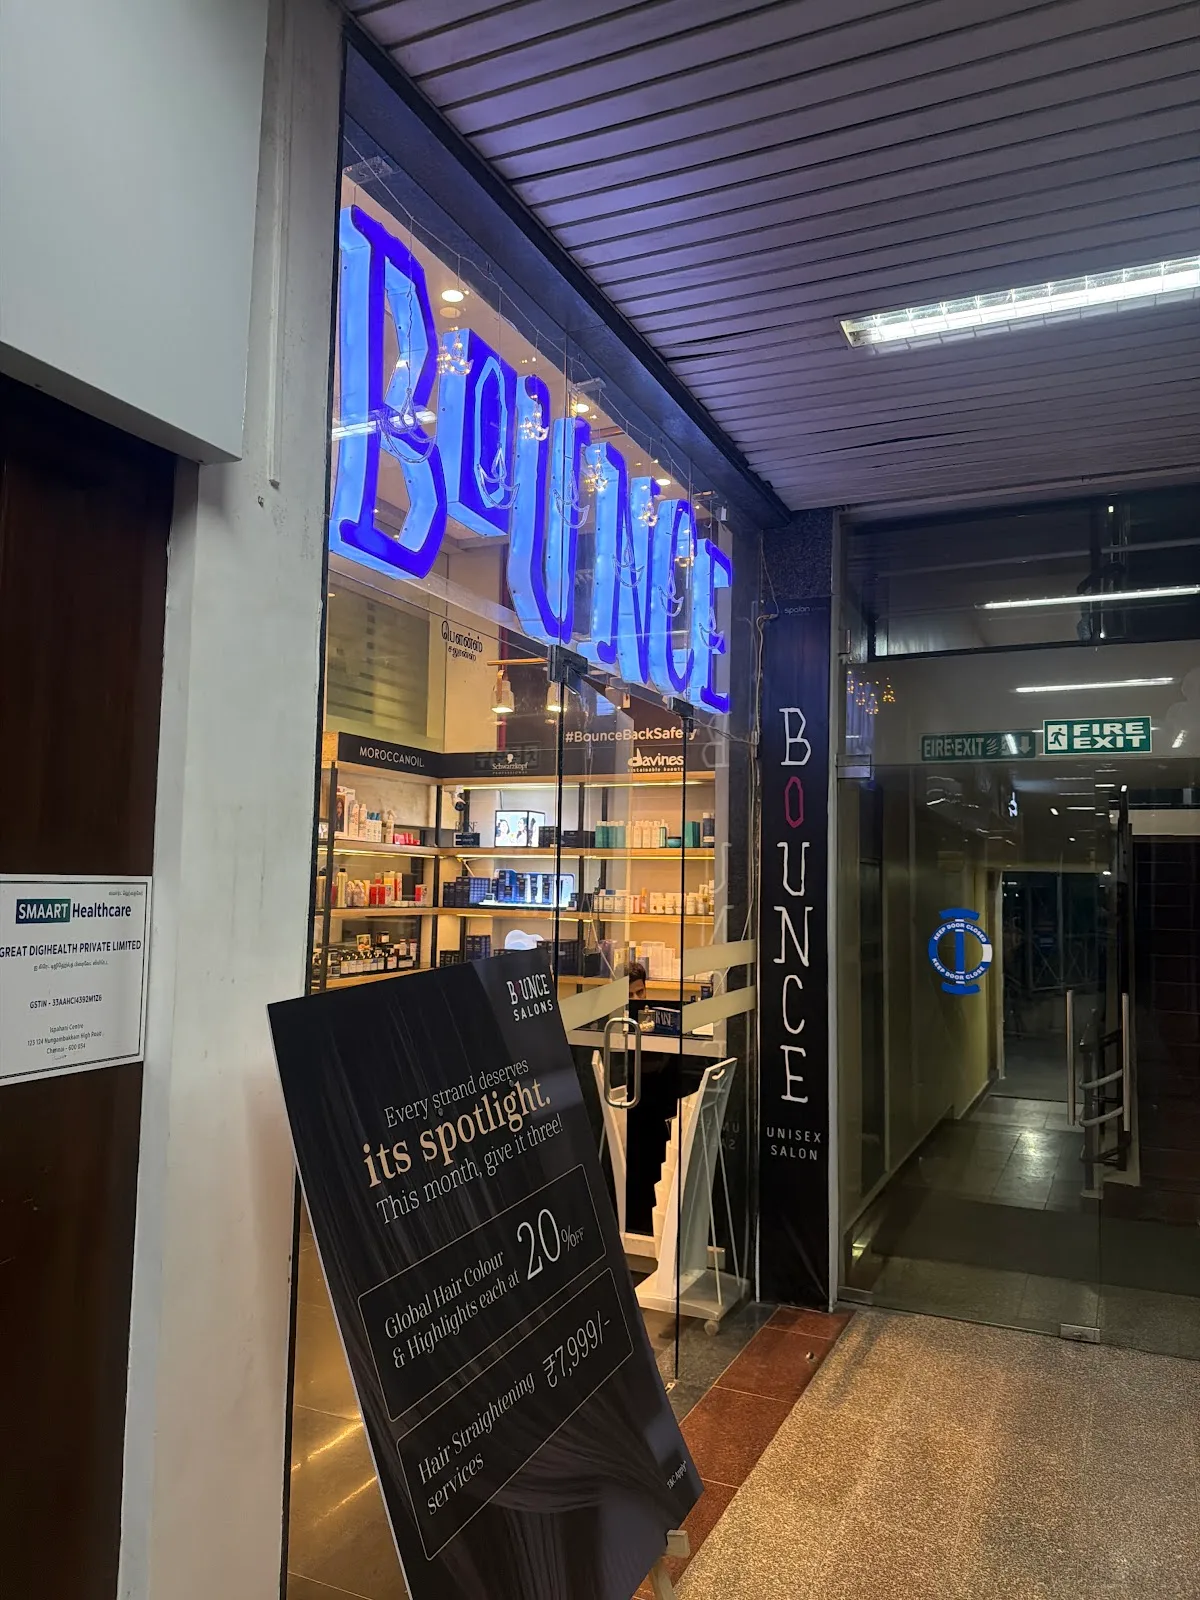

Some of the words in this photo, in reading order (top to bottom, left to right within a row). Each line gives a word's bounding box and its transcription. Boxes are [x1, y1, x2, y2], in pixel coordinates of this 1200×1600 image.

[328, 204, 733, 714] BOUNCE
[565, 727, 698, 743] #BounceBackSafey
[1073, 722, 1144, 736] FIRE
[954, 737, 985, 756] EXIT
[1073, 735, 1147, 749] EXIT
[492, 761, 529, 771] Schwarzkopf
[627, 747, 684, 767] davines
[18, 903, 69, 920] SMAART
[72, 902, 132, 918] Healthcare
[773, 707, 814, 1104] BOUNCE
[933, 926, 946, 941] KEEP
[946, 922, 965, 930] DOOR
[965, 924, 987, 943] CLOSED
[29, 943, 78, 957] DIGIHEALTH
[79, 941, 111, 953] PRIVATE
[112, 940, 142, 951] LIMITED
[932, 958, 946, 973] KEEP
[945, 971, 965, 980] DOOR
[965, 965, 986, 980] CLOSE
[30, 1000, 48, 1009] GSTIN
[513, 999, 553, 1021] SALONS
[80, 1031, 90, 1040] High
[384, 1096, 429, 1129] Every
[432, 1076, 477, 1111] strand
[478, 1059, 529, 1091] deserves
[363, 1141, 412, 1188] its
[419, 1078, 552, 1166] spotlight.
[766, 1126, 822, 1144] UNISEX
[770, 1144, 818, 1161] SALON
[376, 1187, 421, 1225] This
[423, 1157, 483, 1204] month,
[483, 1143, 513, 1177] give
[515, 1133, 528, 1156] it
[527, 1112, 564, 1146] three!
[384, 1293, 433, 1340] Global
[433, 1277, 463, 1309] Hair
[463, 1250, 504, 1288] Colour
[393, 1347, 406, 1369] &
[405, 1299, 479, 1361] Highlights
[479, 1278, 509, 1309] each
[508, 1270, 521, 1290] at
[418, 1445, 451, 1485] Hair
[451, 1371, 536, 1454] Straightening
[426, 1452, 485, 1516] services
